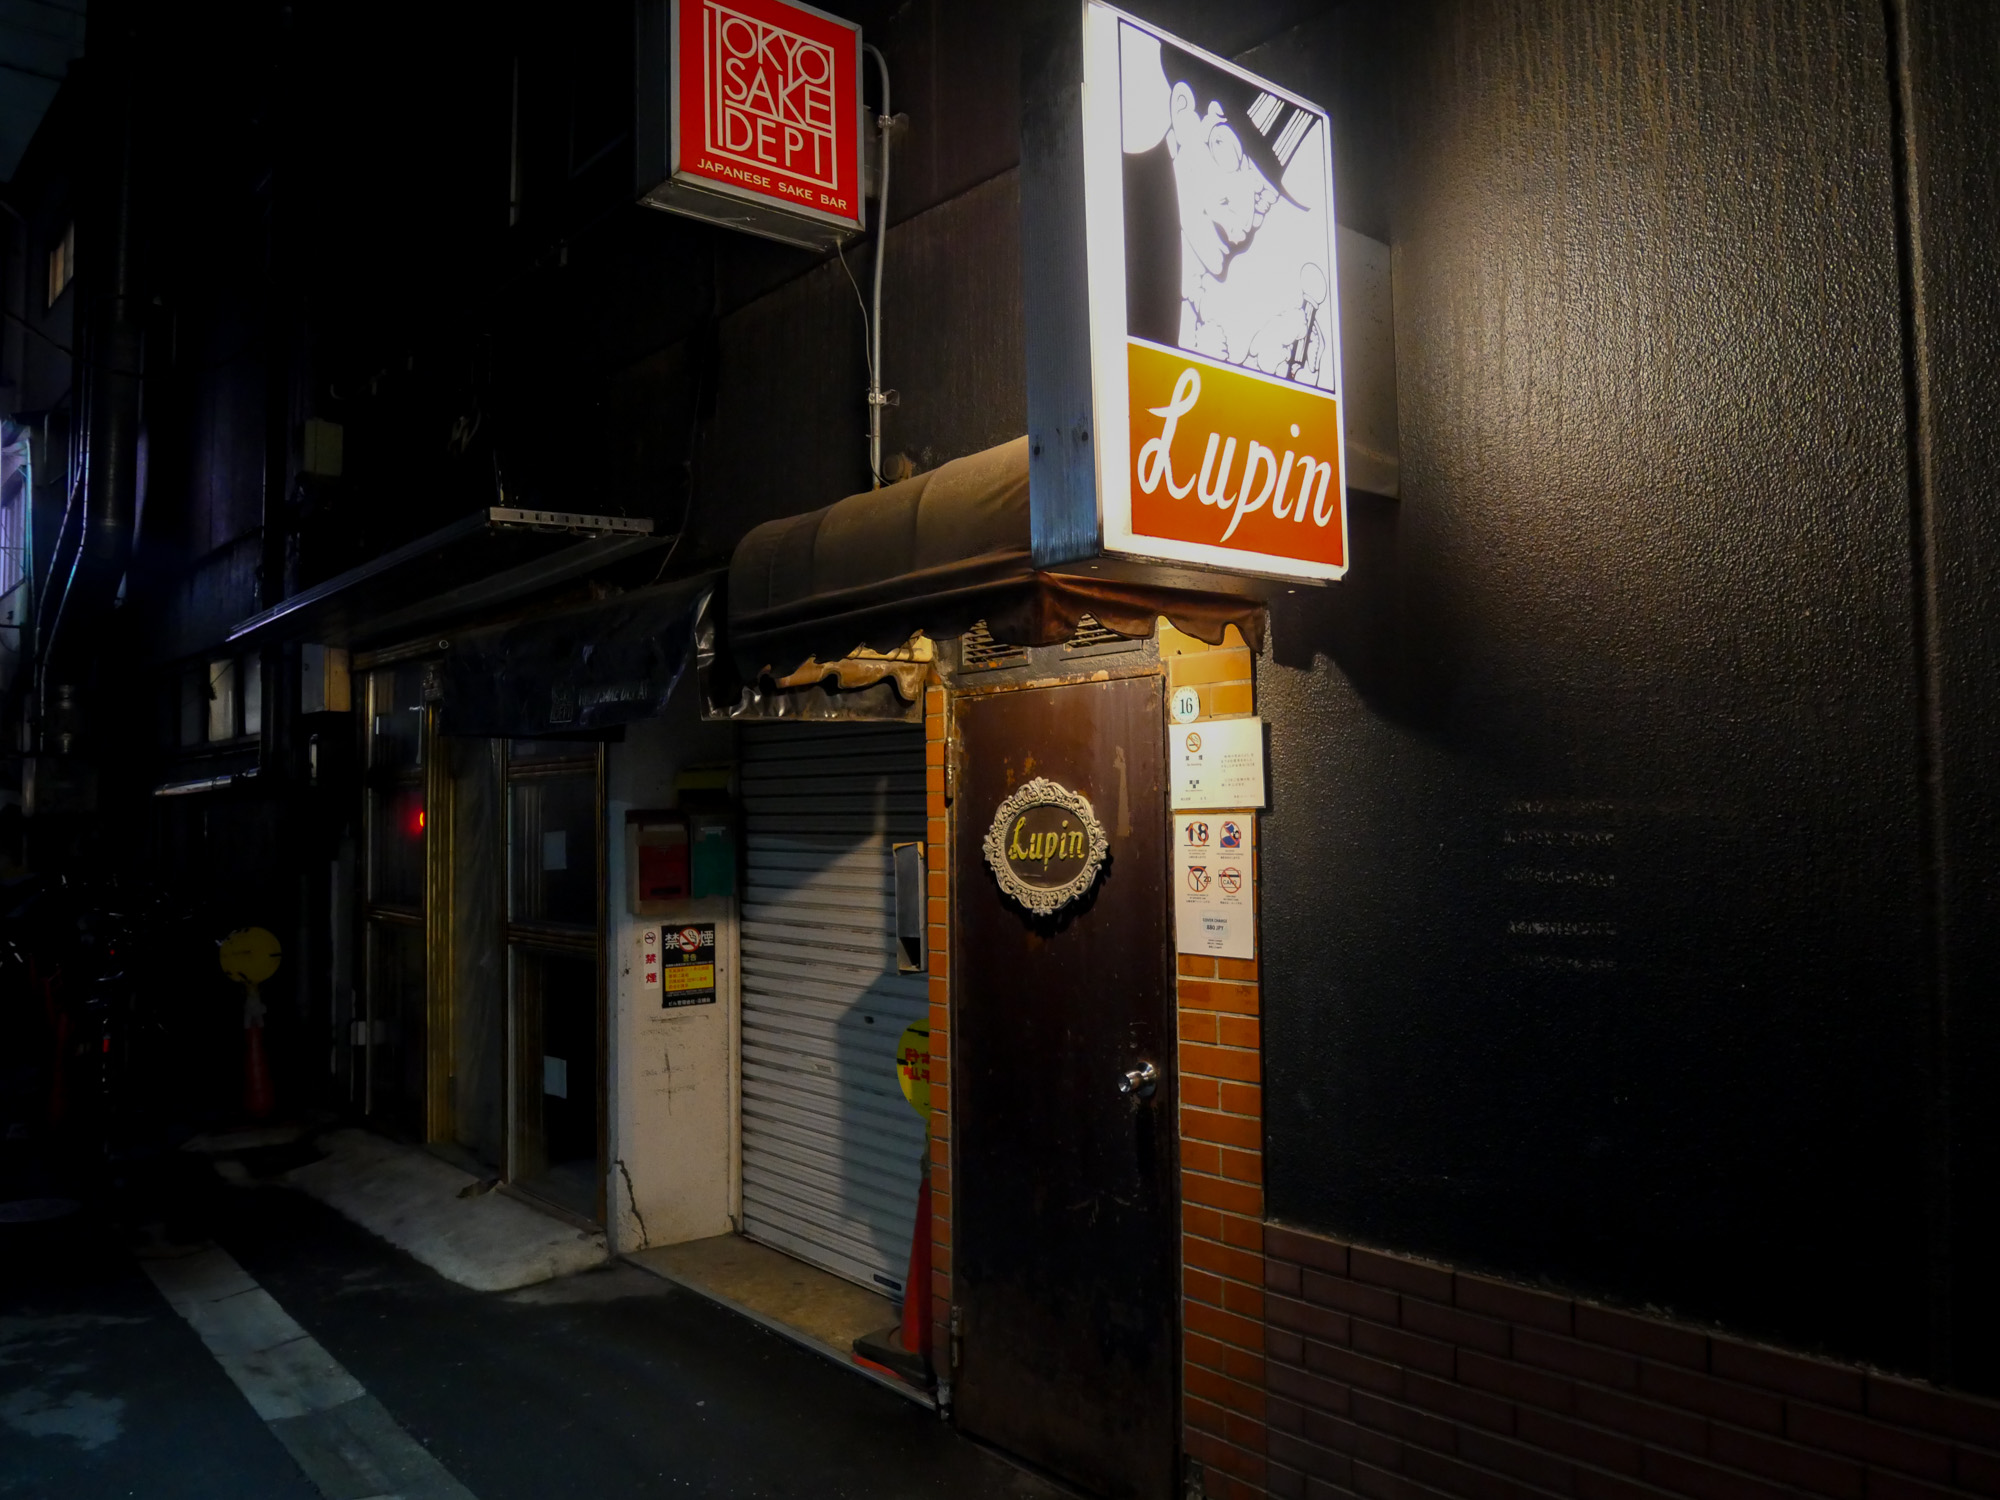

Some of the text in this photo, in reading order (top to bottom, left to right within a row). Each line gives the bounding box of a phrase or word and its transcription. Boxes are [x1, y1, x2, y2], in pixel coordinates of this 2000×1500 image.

[724, 57, 832, 133] SAKE
[725, 107, 833, 175] DEPT
[697, 158, 847, 210] JAPANESE SAKE BAR
[1137, 367, 1333, 543] Lupin
[1180, 697, 1193, 715] 16
[1008, 816, 1085, 872] Lupin
[1186, 822, 1209, 842] 18
